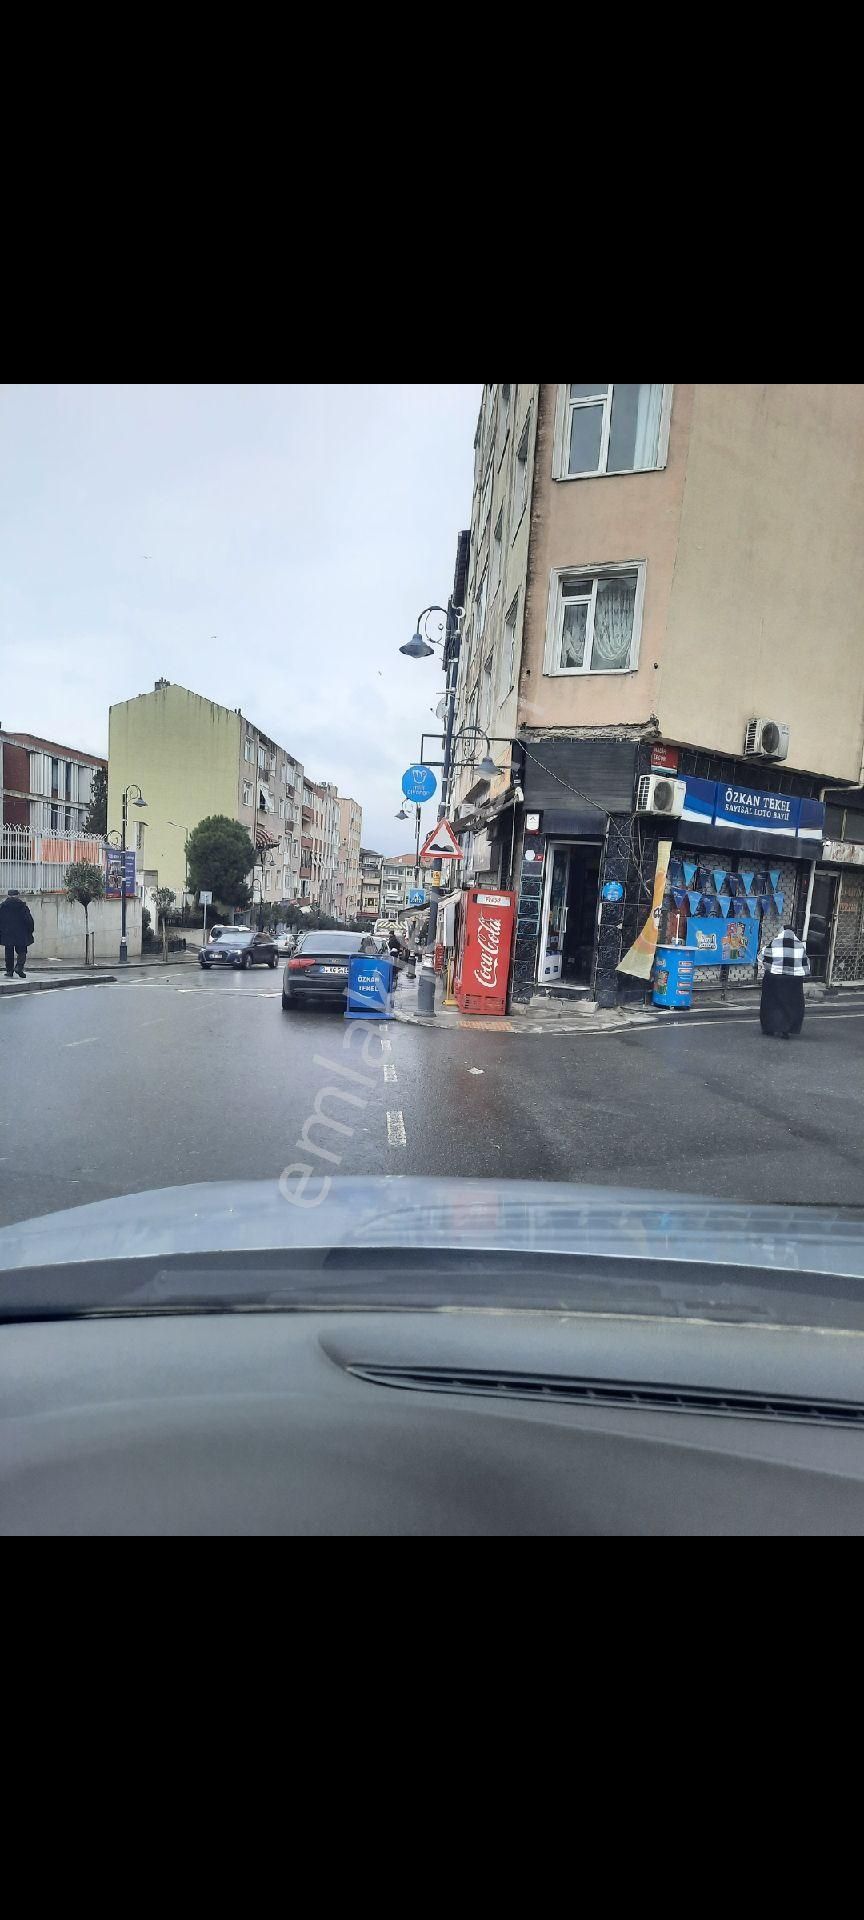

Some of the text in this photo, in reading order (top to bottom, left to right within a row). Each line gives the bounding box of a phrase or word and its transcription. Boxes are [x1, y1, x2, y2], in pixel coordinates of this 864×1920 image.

[725, 787, 791, 812] ÖZKAN TEKEL
[357, 974, 380, 983] ÖZKAN
